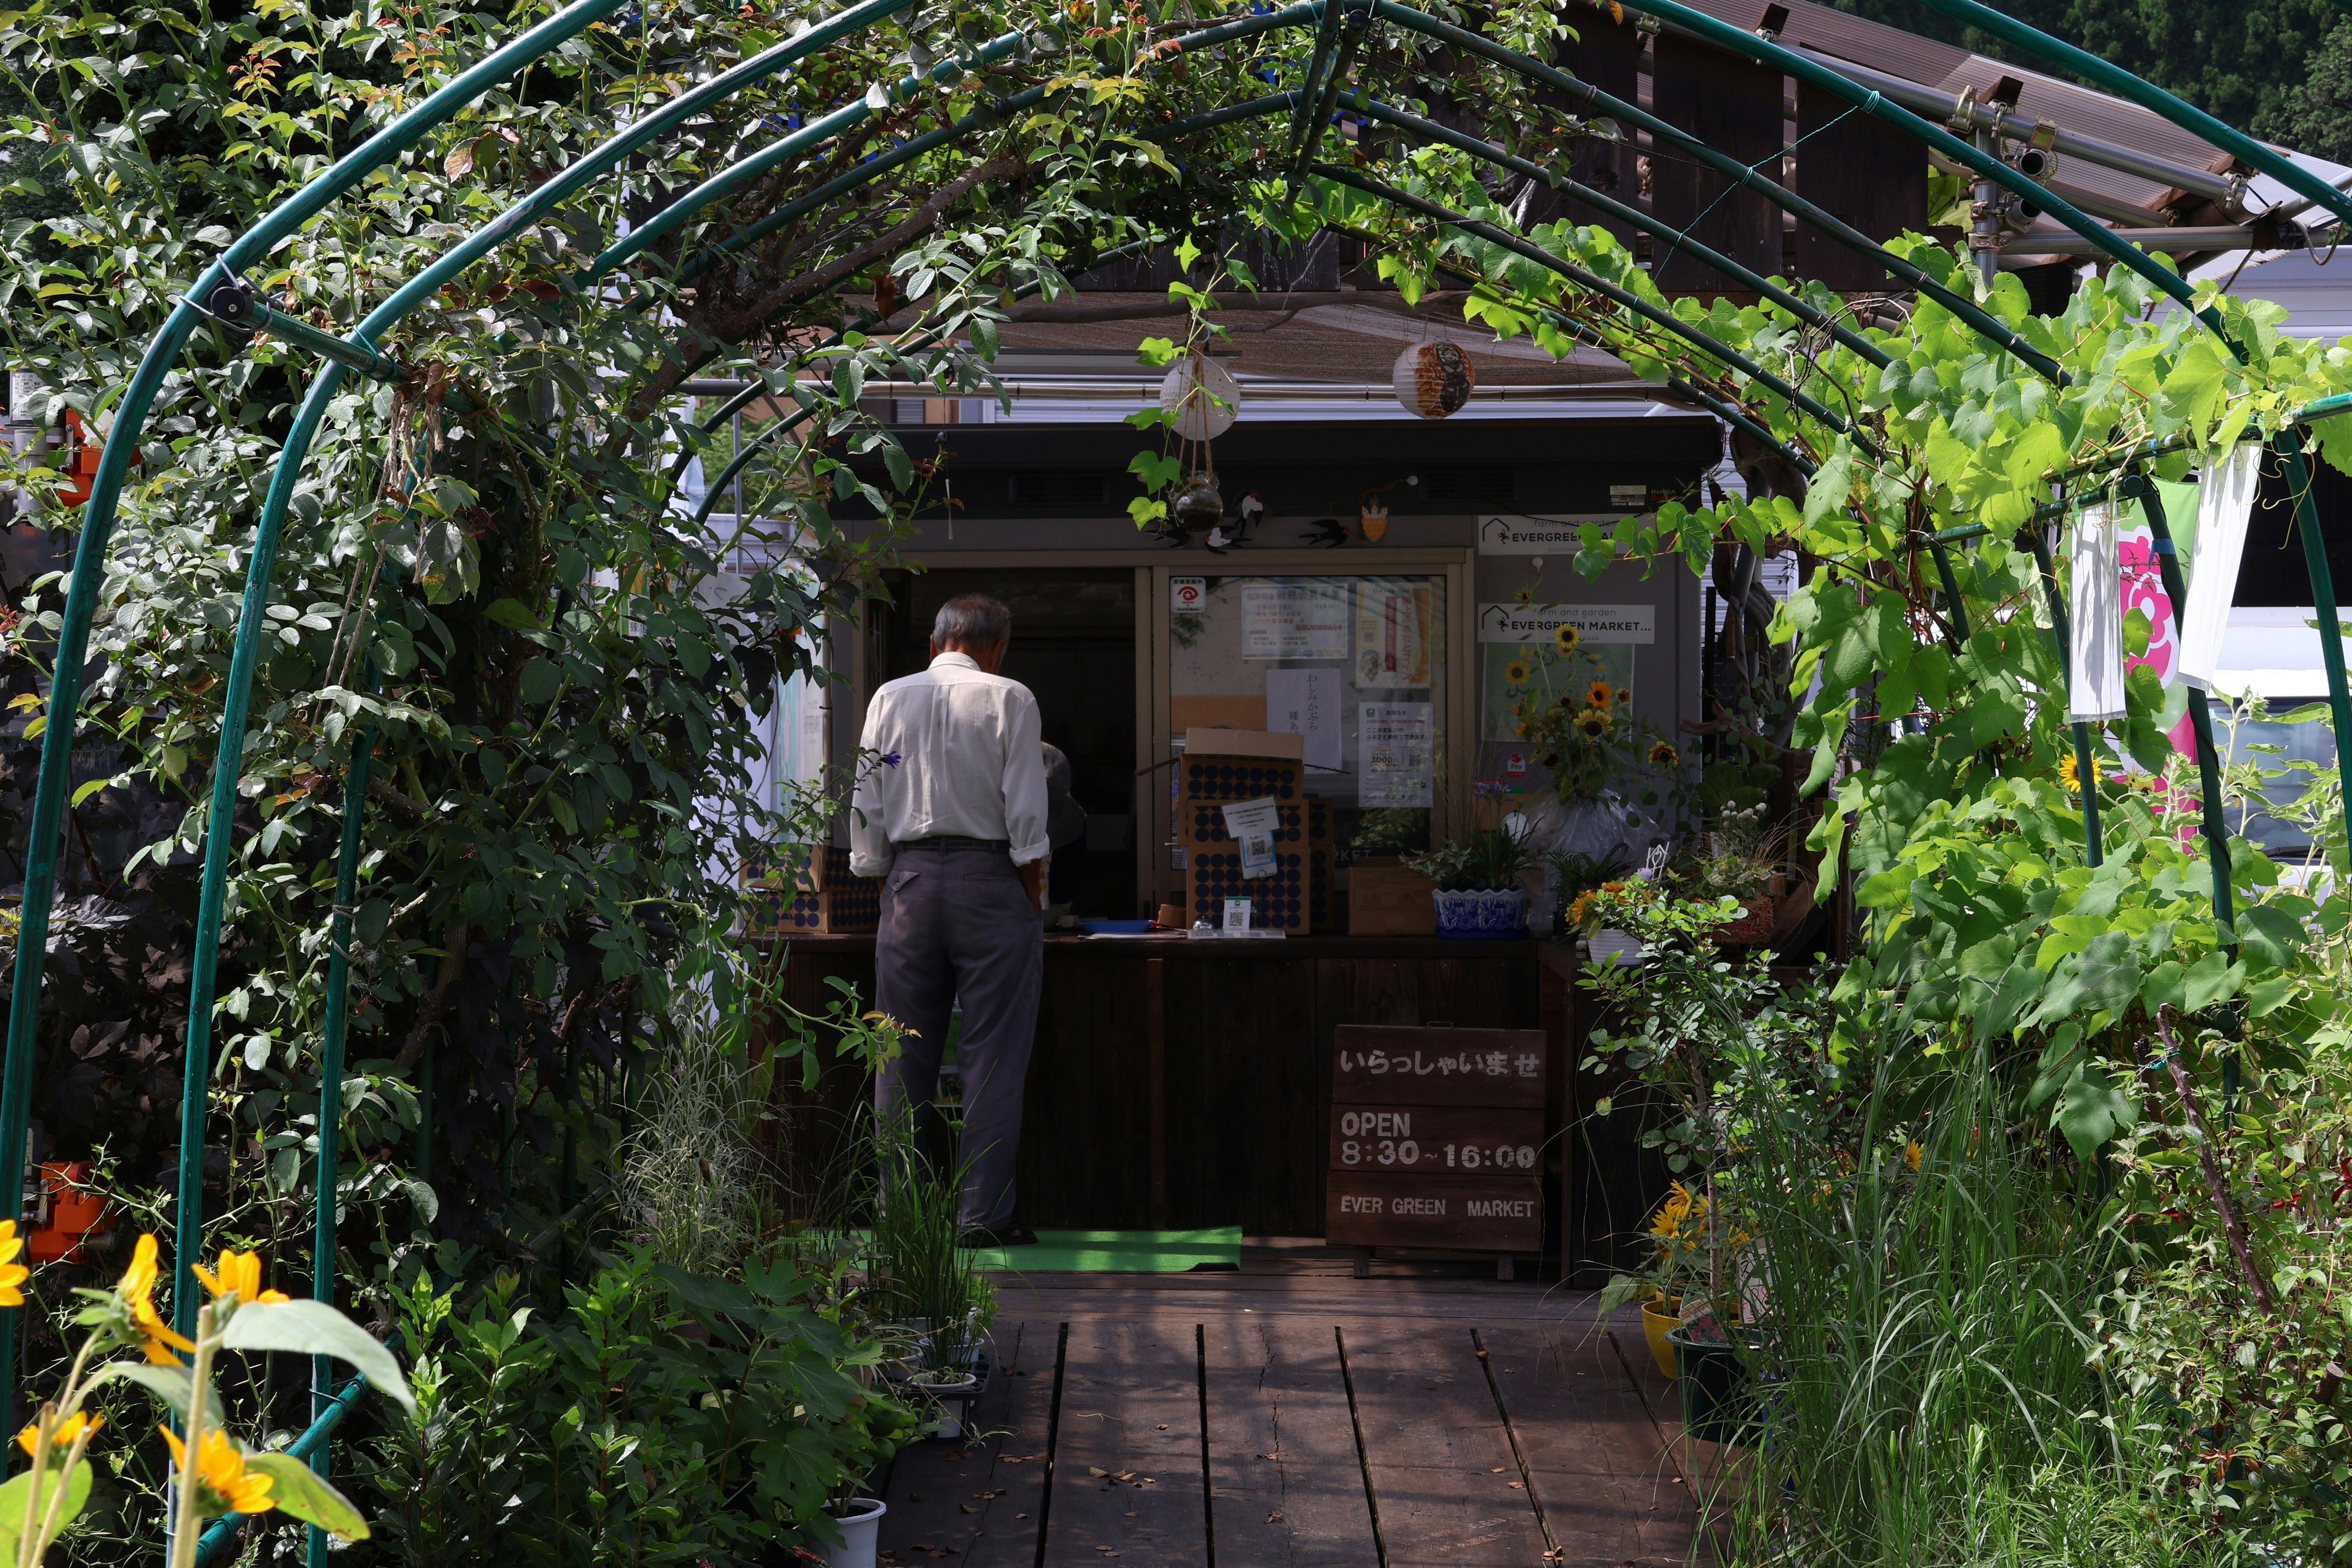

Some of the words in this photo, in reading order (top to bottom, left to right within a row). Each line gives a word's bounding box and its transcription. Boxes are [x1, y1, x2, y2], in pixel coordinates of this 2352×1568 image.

[1561, 519, 1579, 527] and
[1512, 533, 1581, 542] EVERGREE
[1582, 608, 1616, 619] garden
[1512, 621, 1585, 631] EVERGREN
[1307, 673, 1318, 731] わしみかぶら
[1289, 711, 1299, 735] 種あ
[1340, 1049, 1540, 1078] いらっしゃいませ
[1341, 1111, 1411, 1138] OPEN
[1341, 1195, 1384, 1214] EVER
[1392, 1197, 1446, 1215] GREEN
[1467, 1200, 1535, 1217] MARKET
